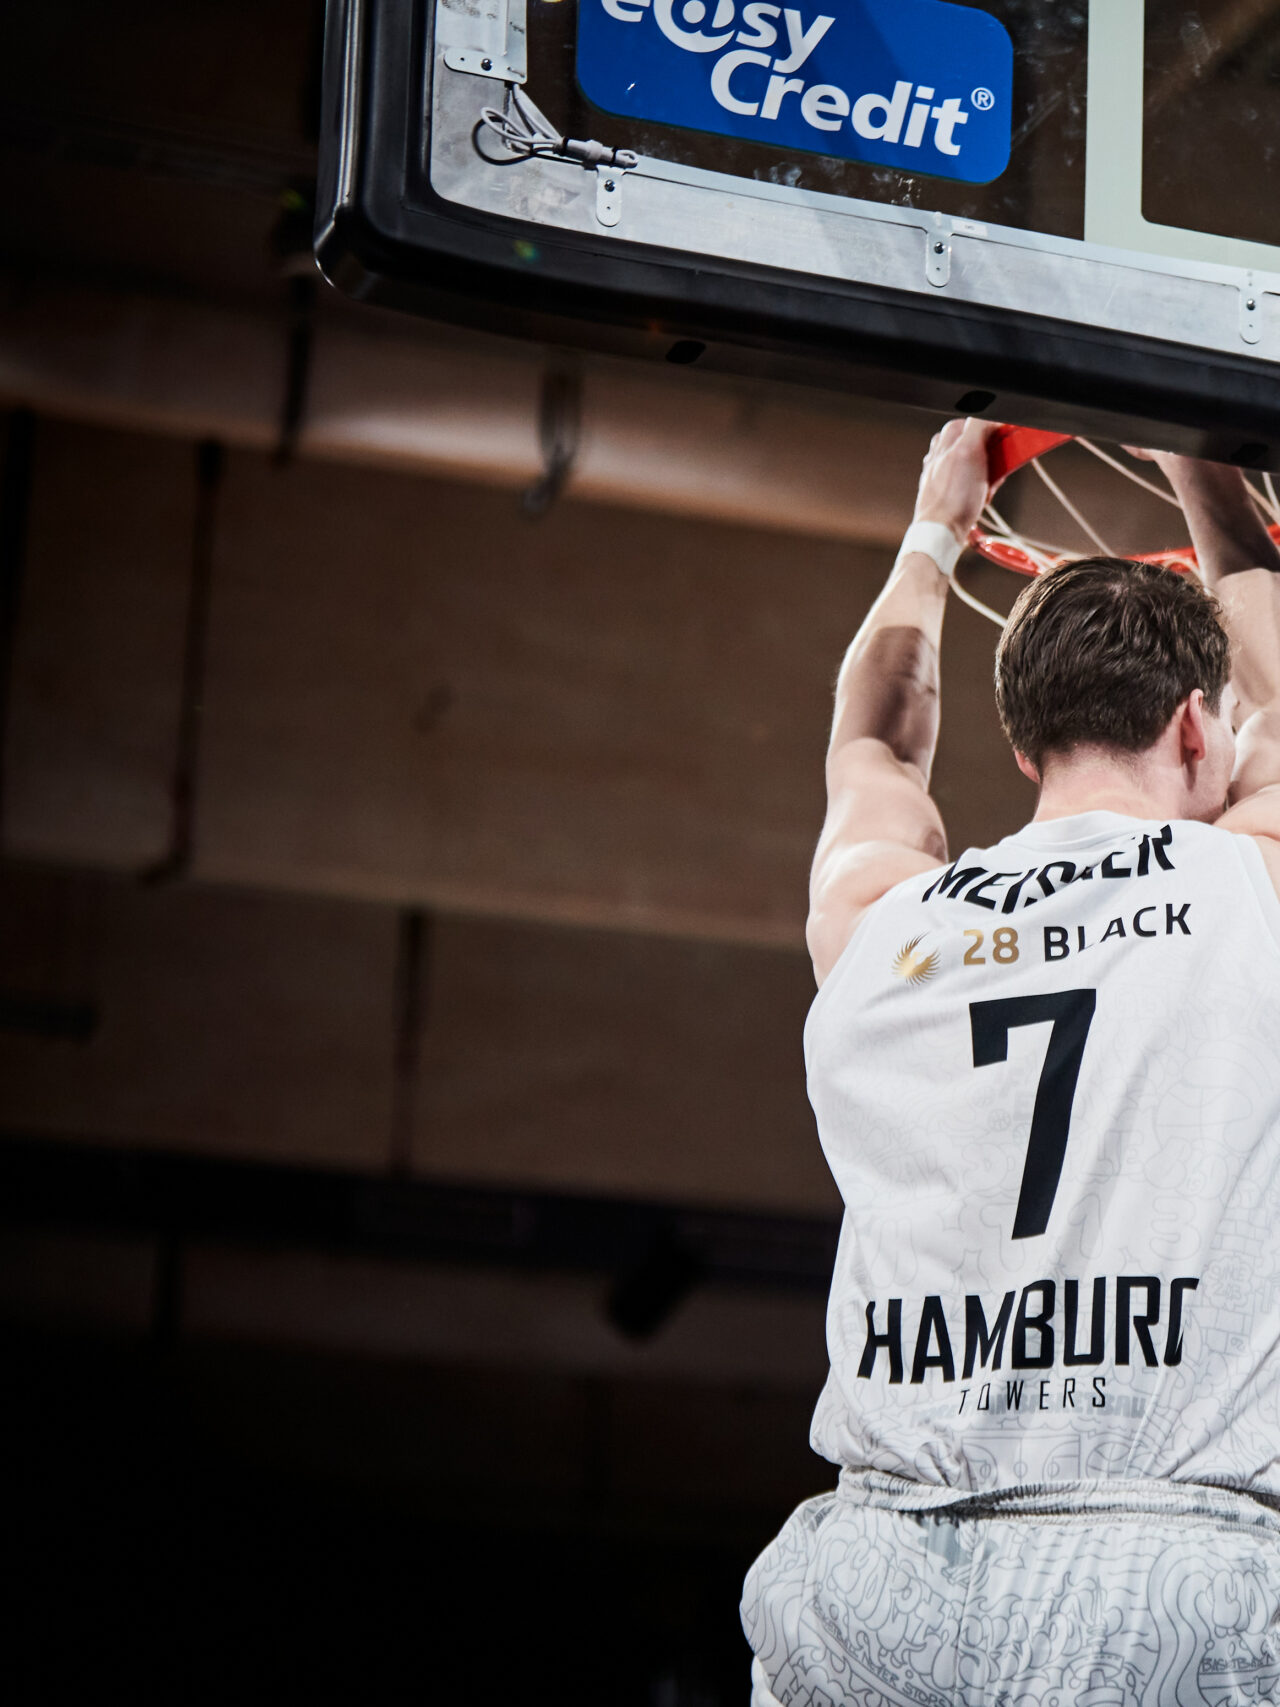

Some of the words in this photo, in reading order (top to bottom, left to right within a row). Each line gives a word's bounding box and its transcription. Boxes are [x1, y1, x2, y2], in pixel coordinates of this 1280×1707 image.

[963, 926, 1020, 966] 28
[1043, 903, 1192, 963] BLACK
[968, 988, 1097, 1240] 7
[958, 1377, 1107, 1415] TOWERS
